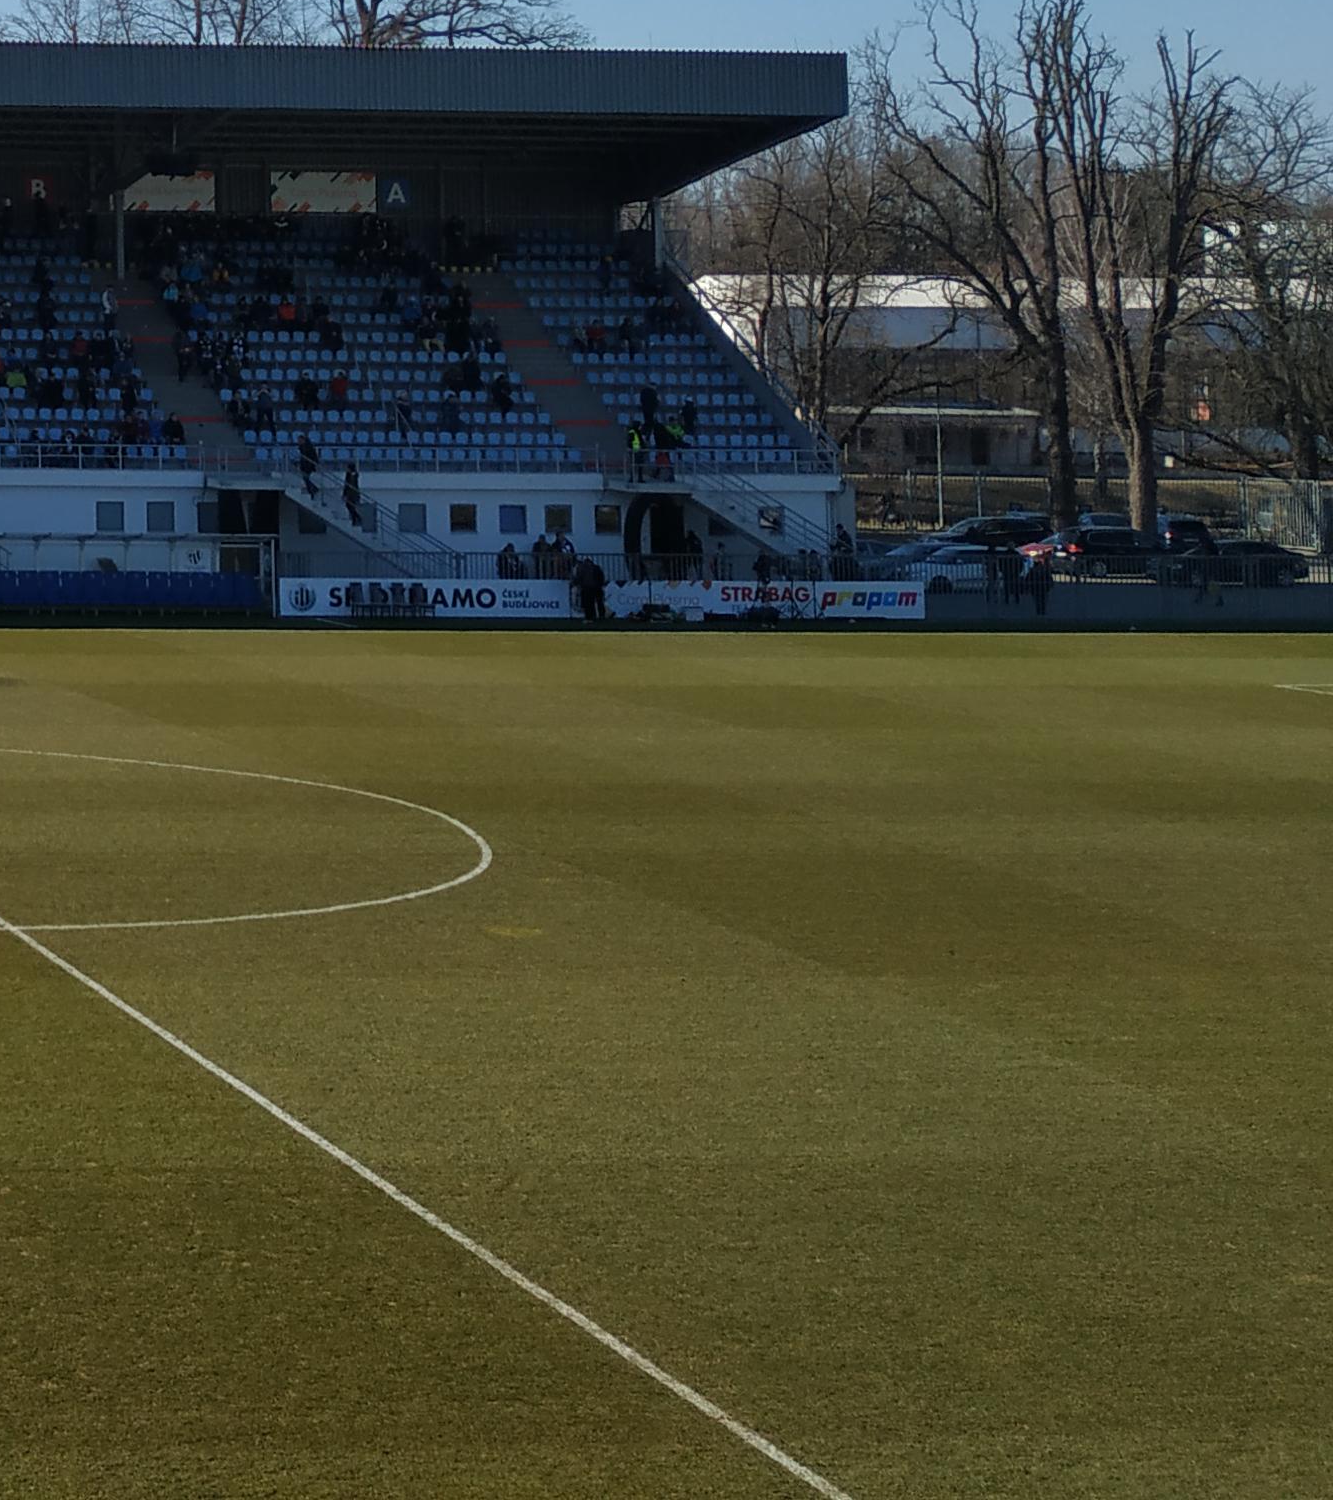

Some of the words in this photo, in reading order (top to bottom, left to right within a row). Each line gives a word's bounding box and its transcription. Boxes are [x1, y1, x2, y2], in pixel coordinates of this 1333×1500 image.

[387, 183, 407, 204] A
[720, 586, 810, 603] STRABAG
[502, 599, 560, 609] BUDĚJOVICE
